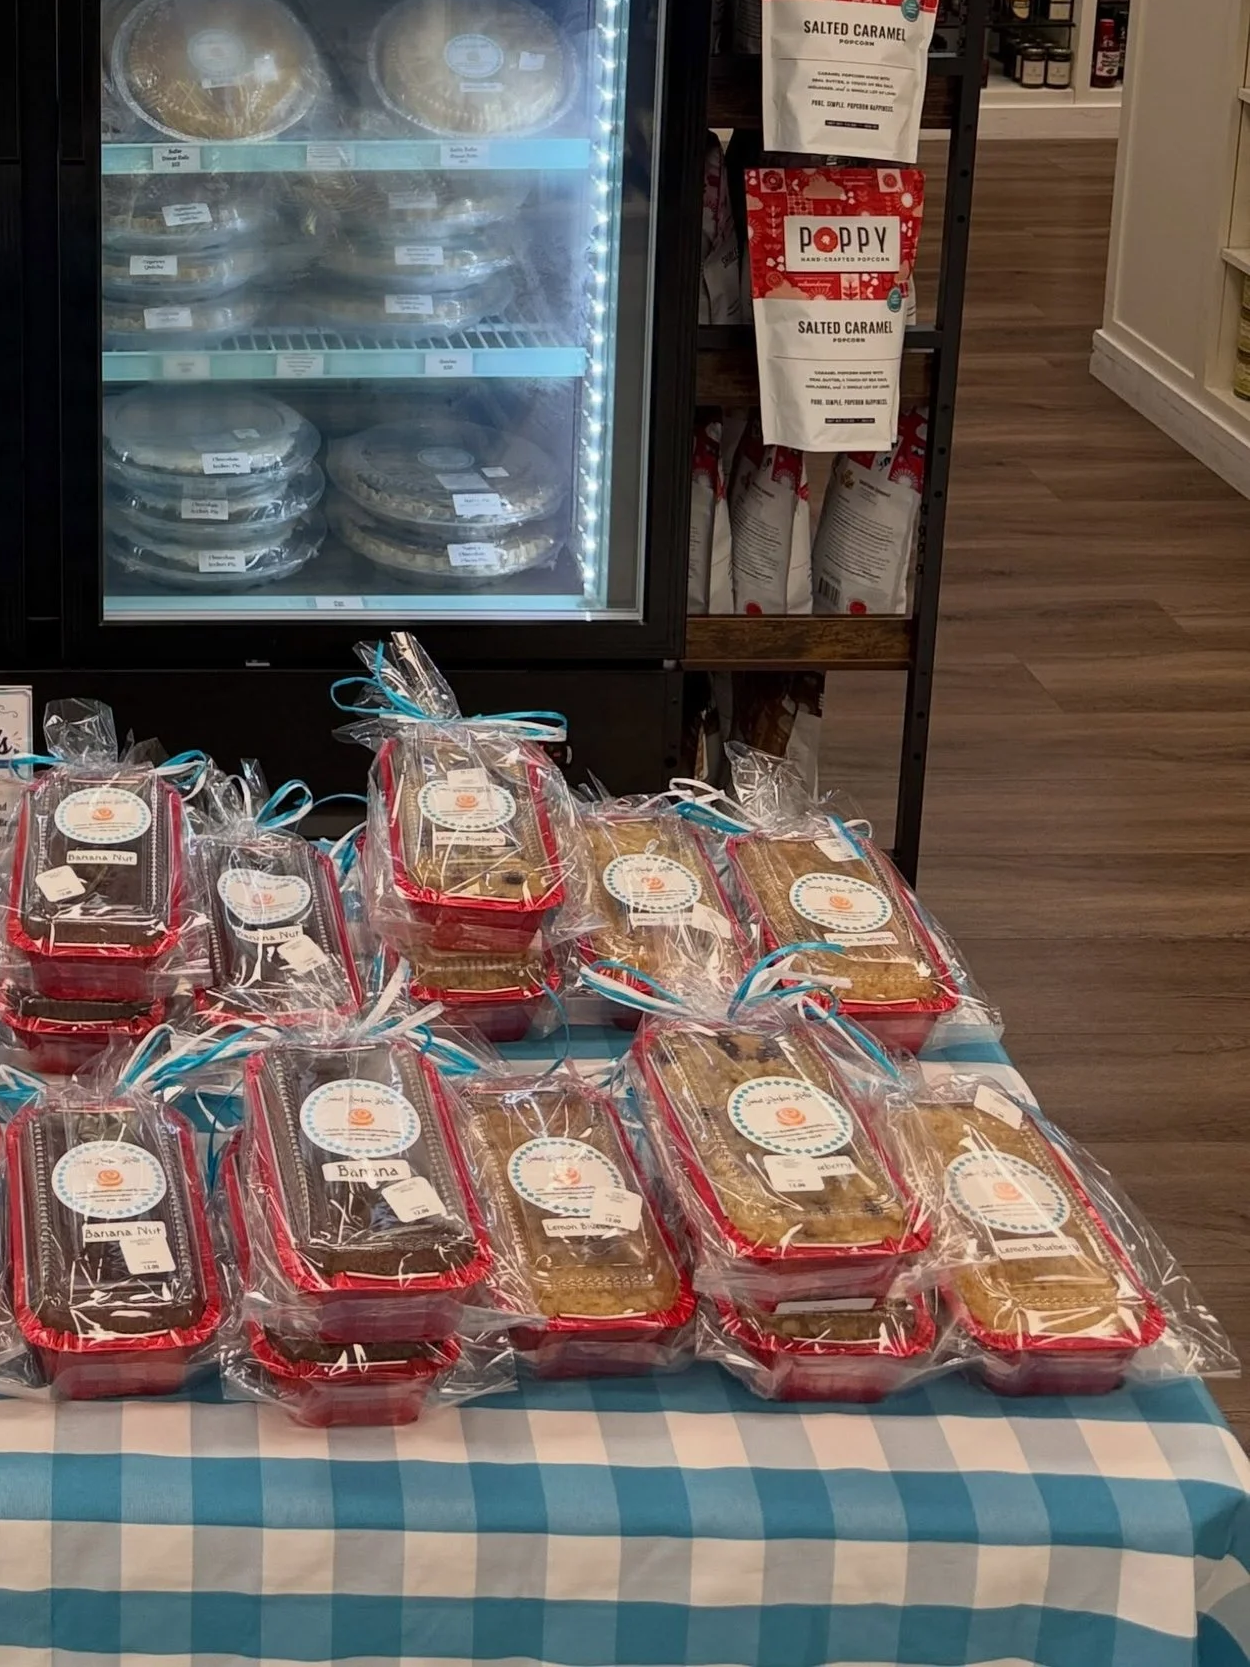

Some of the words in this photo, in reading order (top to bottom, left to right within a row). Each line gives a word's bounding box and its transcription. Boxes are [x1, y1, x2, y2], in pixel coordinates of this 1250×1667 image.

[803, 20, 849, 36] SALTED
[853, 23, 906, 42] CARAMEL
[838, 38, 874, 47] POPCORN
[798, 321, 841, 334] SALTED
[844, 321, 893, 335] CARAMEL
[68, 853, 109, 862] Banana
[84, 1227, 132, 1239] Banana
[136, 1226, 162, 1237] Nut
[546, 1223, 577, 1232] Lemon
[998, 1244, 1032, 1255] Lemon
